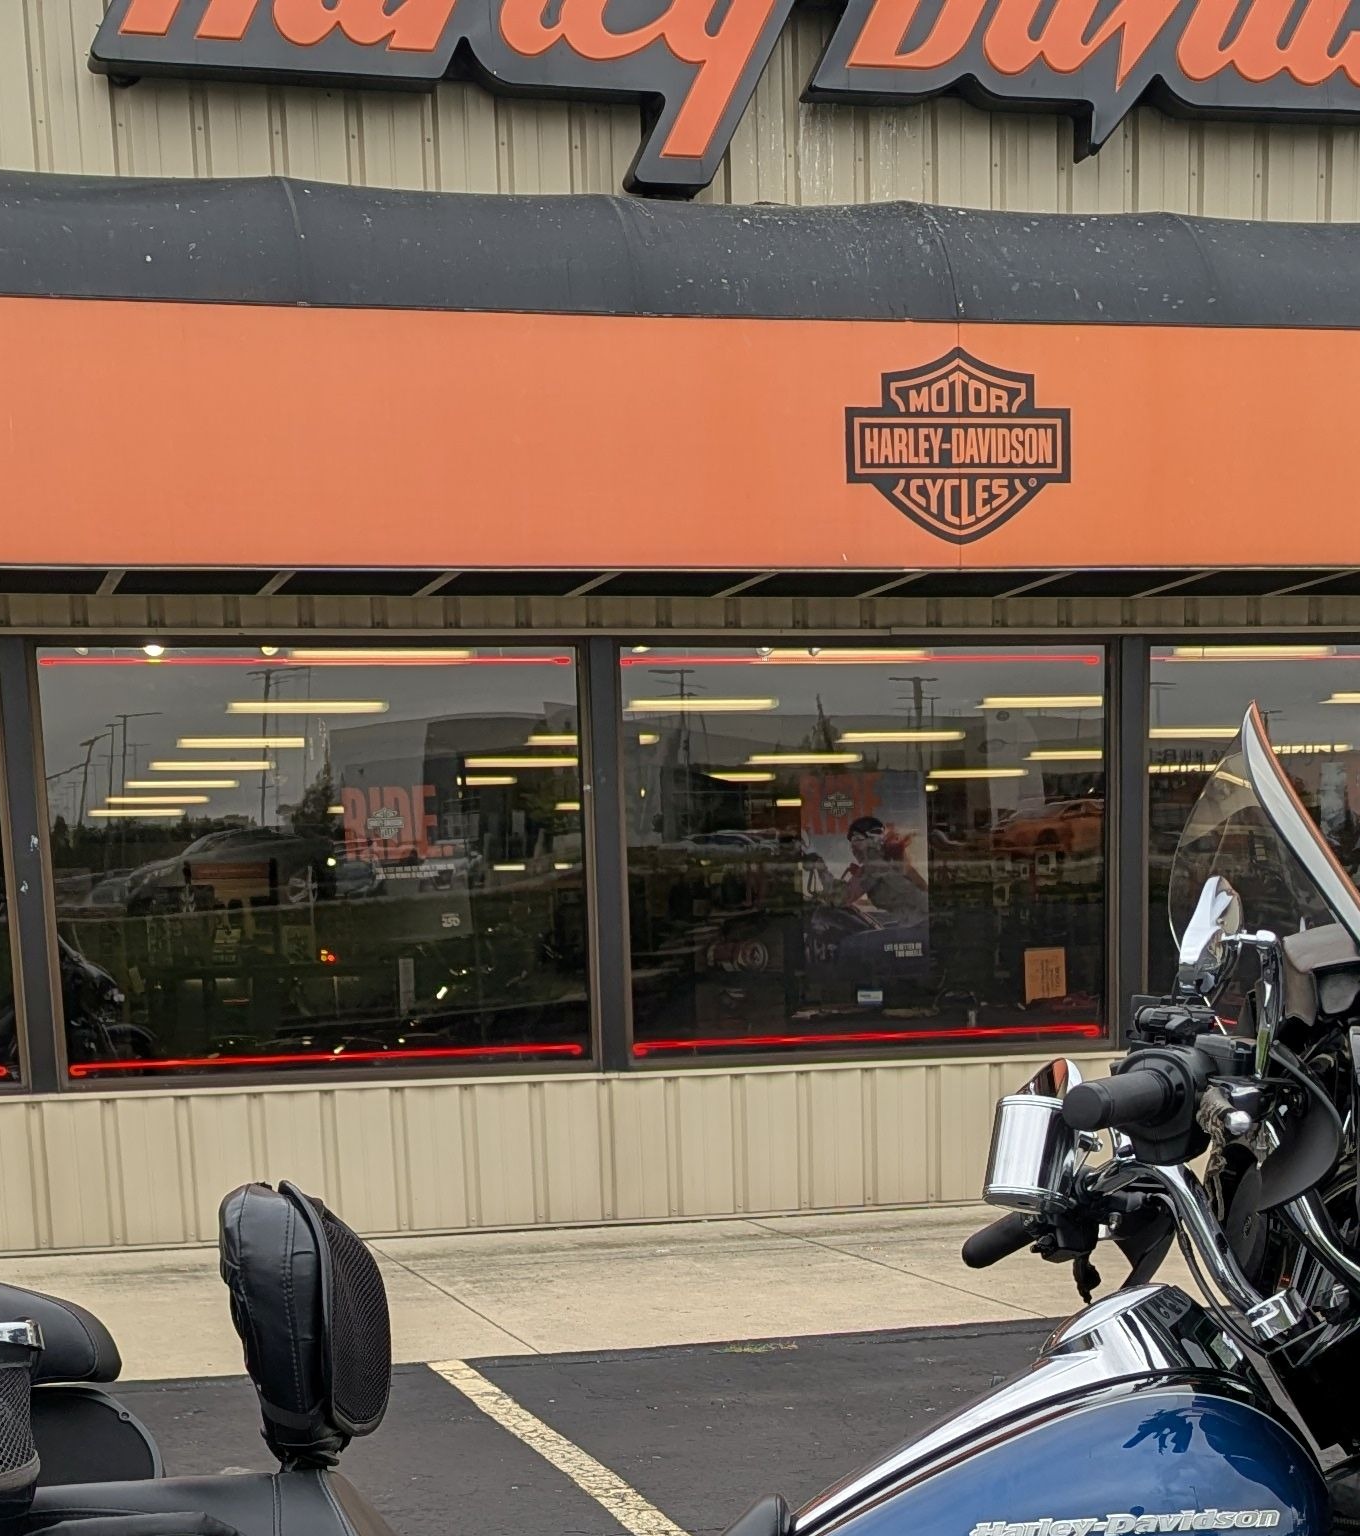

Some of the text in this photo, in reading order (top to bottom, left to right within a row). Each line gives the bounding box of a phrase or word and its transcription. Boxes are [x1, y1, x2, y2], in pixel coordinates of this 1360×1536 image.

[908, 370, 1009, 413] MOTOR
[864, 427, 1053, 464] HARLEY-DAVIDSON
[909, 478, 1010, 525] CYCLES
